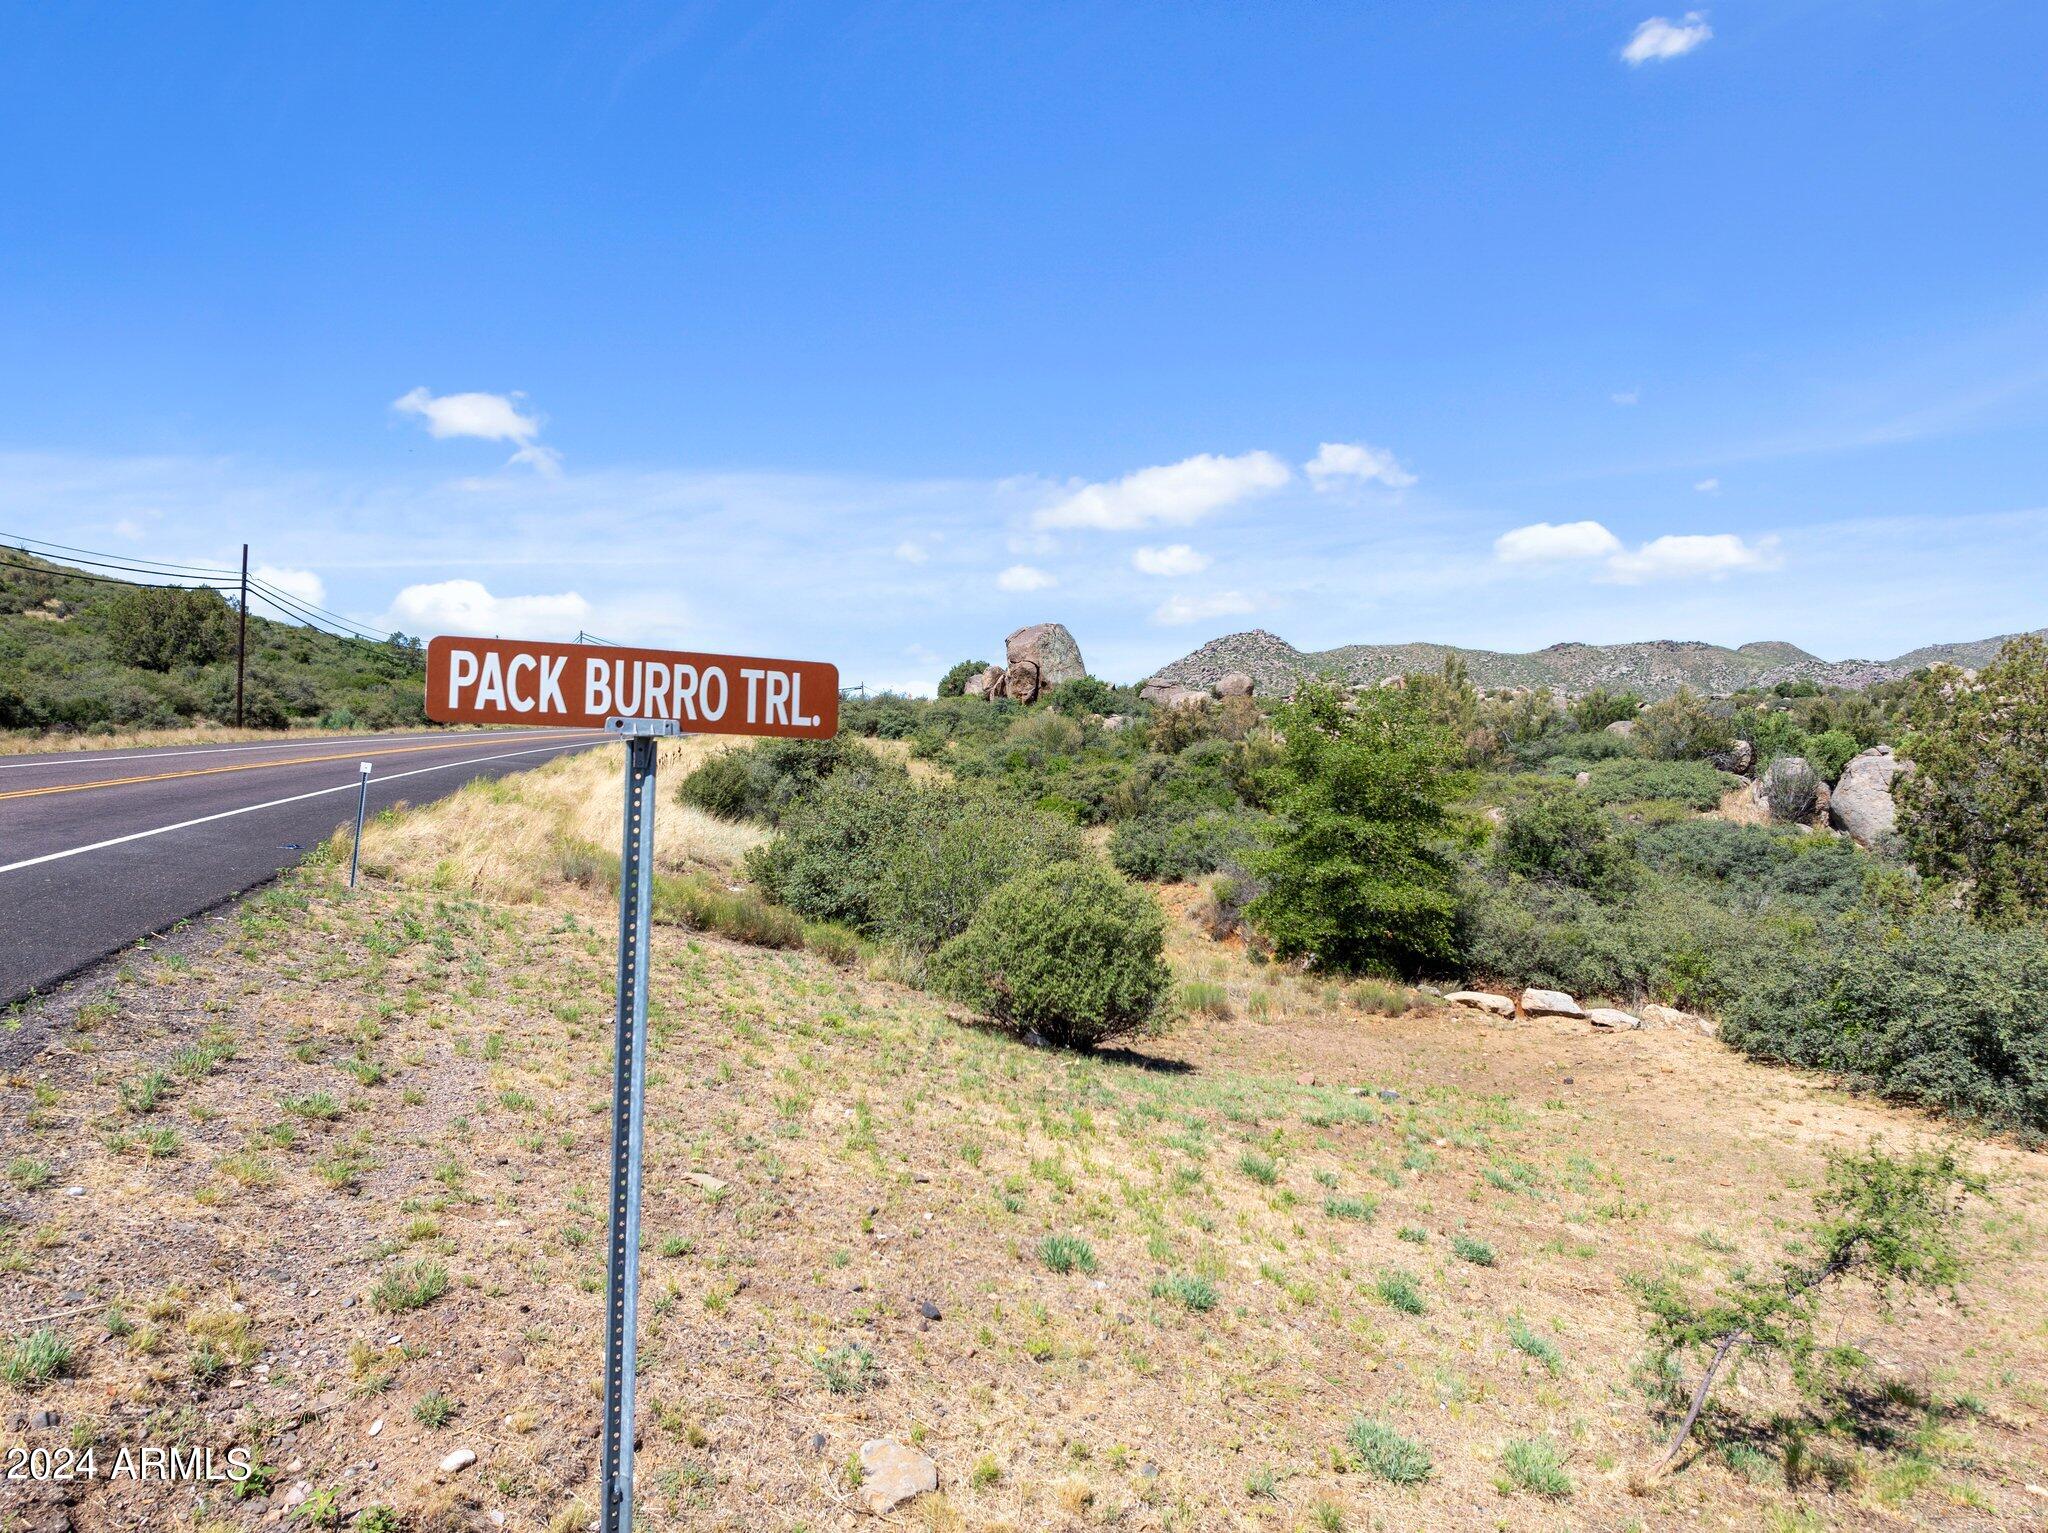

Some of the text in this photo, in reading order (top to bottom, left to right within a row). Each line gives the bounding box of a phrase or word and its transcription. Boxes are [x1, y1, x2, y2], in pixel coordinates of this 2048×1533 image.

[448, 649, 821, 727] PACK BURRO TRL.
